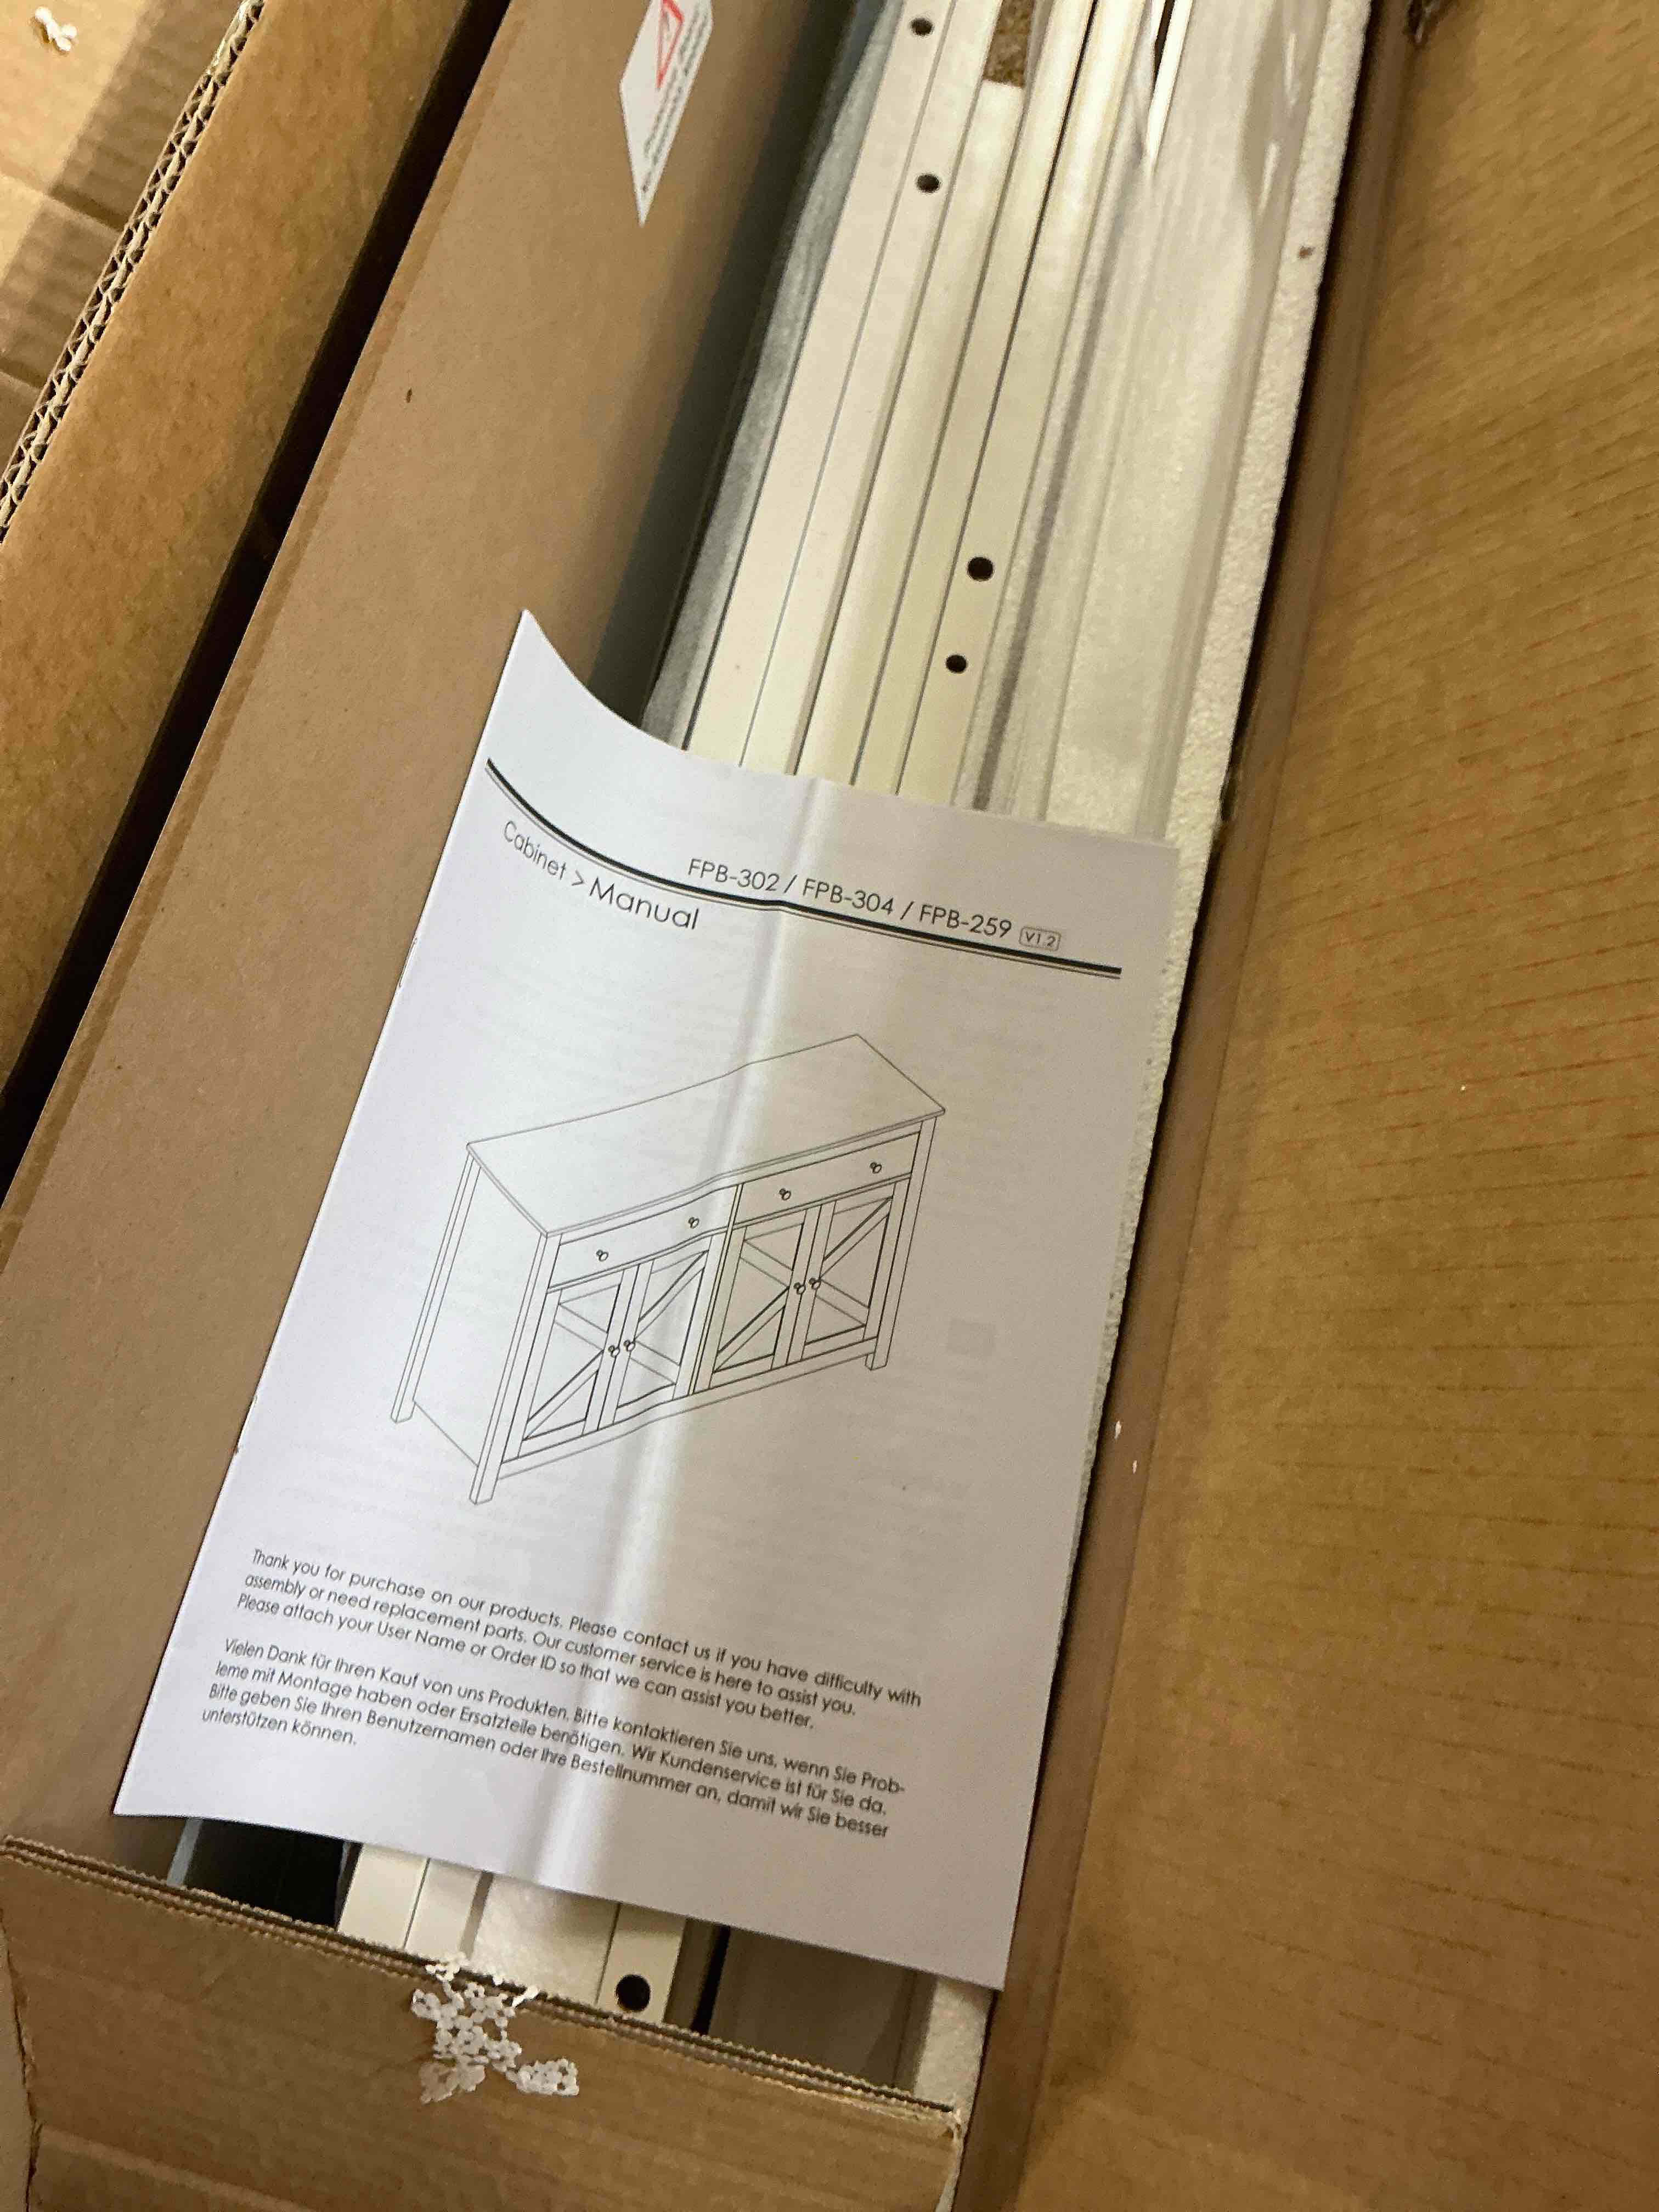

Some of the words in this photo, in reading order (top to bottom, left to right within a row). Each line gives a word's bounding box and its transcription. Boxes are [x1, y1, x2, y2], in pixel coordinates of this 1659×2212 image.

[504, 820, 567, 881] Cabinet
[589, 877, 699, 930] Manual
[688, 858, 780, 891] FPB-302
[803, 878, 894, 915] FPB-304
[919, 904, 1012, 938] FPB-259
[237, 1593, 279, 1614] Please
[283, 1604, 333, 1625] attach
[337, 1615, 374, 1633] your
[377, 1620, 411, 1640] User
[415, 1629, 466, 1652] Name
[470, 1644, 486, 1656] or
[491, 1645, 537, 1667] Order
[540, 1655, 556, 1671] ID
[560, 1661, 575, 1675] so
[579, 1663, 610, 1682] that
[614, 1673, 640, 1689] we
[645, 1679, 677, 1697] can
[681, 1688, 721, 1708] assist
[725, 1697, 755, 1716] you
[760, 1702, 814, 1729] better.
[245, 1573, 306, 1599] assembly
[308, 1586, 325, 1600] or
[327, 1590, 371, 1610] need
[373, 1600, 480, 1633] replacement
[483, 1624, 527, 1643] parts.
[533, 1630, 562, 1647] Our
[565, 1640, 636, 1665] customer
[640, 1656, 696, 1679] service
[700, 1666, 710, 1683] is
[715, 1669, 752, 1692] here
[757, 1679, 773, 1697] to
[778, 1686, 818, 1707] assist
[821, 1697, 856, 1716] you.
[252, 1548, 290, 1570] Thank
[293, 1559, 320, 1577] you
[325, 1564, 346, 1582] for
[349, 1571, 425, 1599] purchase
[431, 1590, 453, 1605] on
[459, 1596, 485, 1611] our
[489, 1602, 563, 1628] products.
[569, 1616, 617, 1638] Please
[623, 1629, 689, 1655] contact
[694, 1647, 710, 1659] us
[716, 1647, 727, 1662] if
[731, 1654, 761, 1671] you
[766, 1658, 809, 1683] have
[814, 1672, 883, 1701] difficulty
[887, 1688, 922, 1707] with
[202, 1707, 288, 1733] unterstützen
[291, 1718, 358, 1746] können.
[208, 1683, 238, 1701] Bitte
[240, 1689, 290, 1710] geben
[294, 1695, 317, 1715] Sie
[320, 1701, 362, 1723] Ihren
[366, 1709, 496, 1751] Benutzernamen
[500, 1741, 539, 1759] oder
[540, 1747, 567, 1767] Ihre
[571, 1753, 692, 1794] Bestellnummer
[696, 1784, 721, 1803] an,
[727, 1790, 776, 1814] damit
[781, 1802, 803, 1820] wir
[807, 1805, 831, 1825] Sie
[834, 1812, 890, 1838] besser
[215, 1659, 249, 1680] leme
[252, 1666, 276, 1683] mit
[278, 1671, 352, 1699] Montage
[356, 1685, 412, 1709] haben
[416, 1700, 456, 1719] oder
[459, 1706, 537, 1736] Ersatzteile
[540, 1723, 625, 1757] benötigen.
[632, 1743, 657, 1762] Wir
[659, 1750, 781, 1791] Kundenservice
[785, 1777, 802, 1796] ist
[806, 1782, 827, 1801] für
[831, 1787, 854, 1807] Sie
[859, 1796, 887, 1816] da.
[224, 1637, 264, 1660] Vielen
[267, 1644, 307, 1667] Dank
[311, 1652, 332, 1669] für
[335, 1657, 375, 1679] Ihren
[379, 1666, 419, 1688] Kauf
[422, 1676, 453, 1696] von
[457, 1685, 484, 1701] uns
[488, 1689, 569, 1722] Produkten.
[574, 1706, 608, 1728] Bitte
[612, 1716, 715, 1753] kontaktieren
[719, 1739, 742, 1759] Sie
[747, 1750, 777, 1768] uns,
[783, 1757, 830, 1779] wenn
[834, 1765, 857, 1784] Sie
[861, 1770, 905, 1793] Prob-
